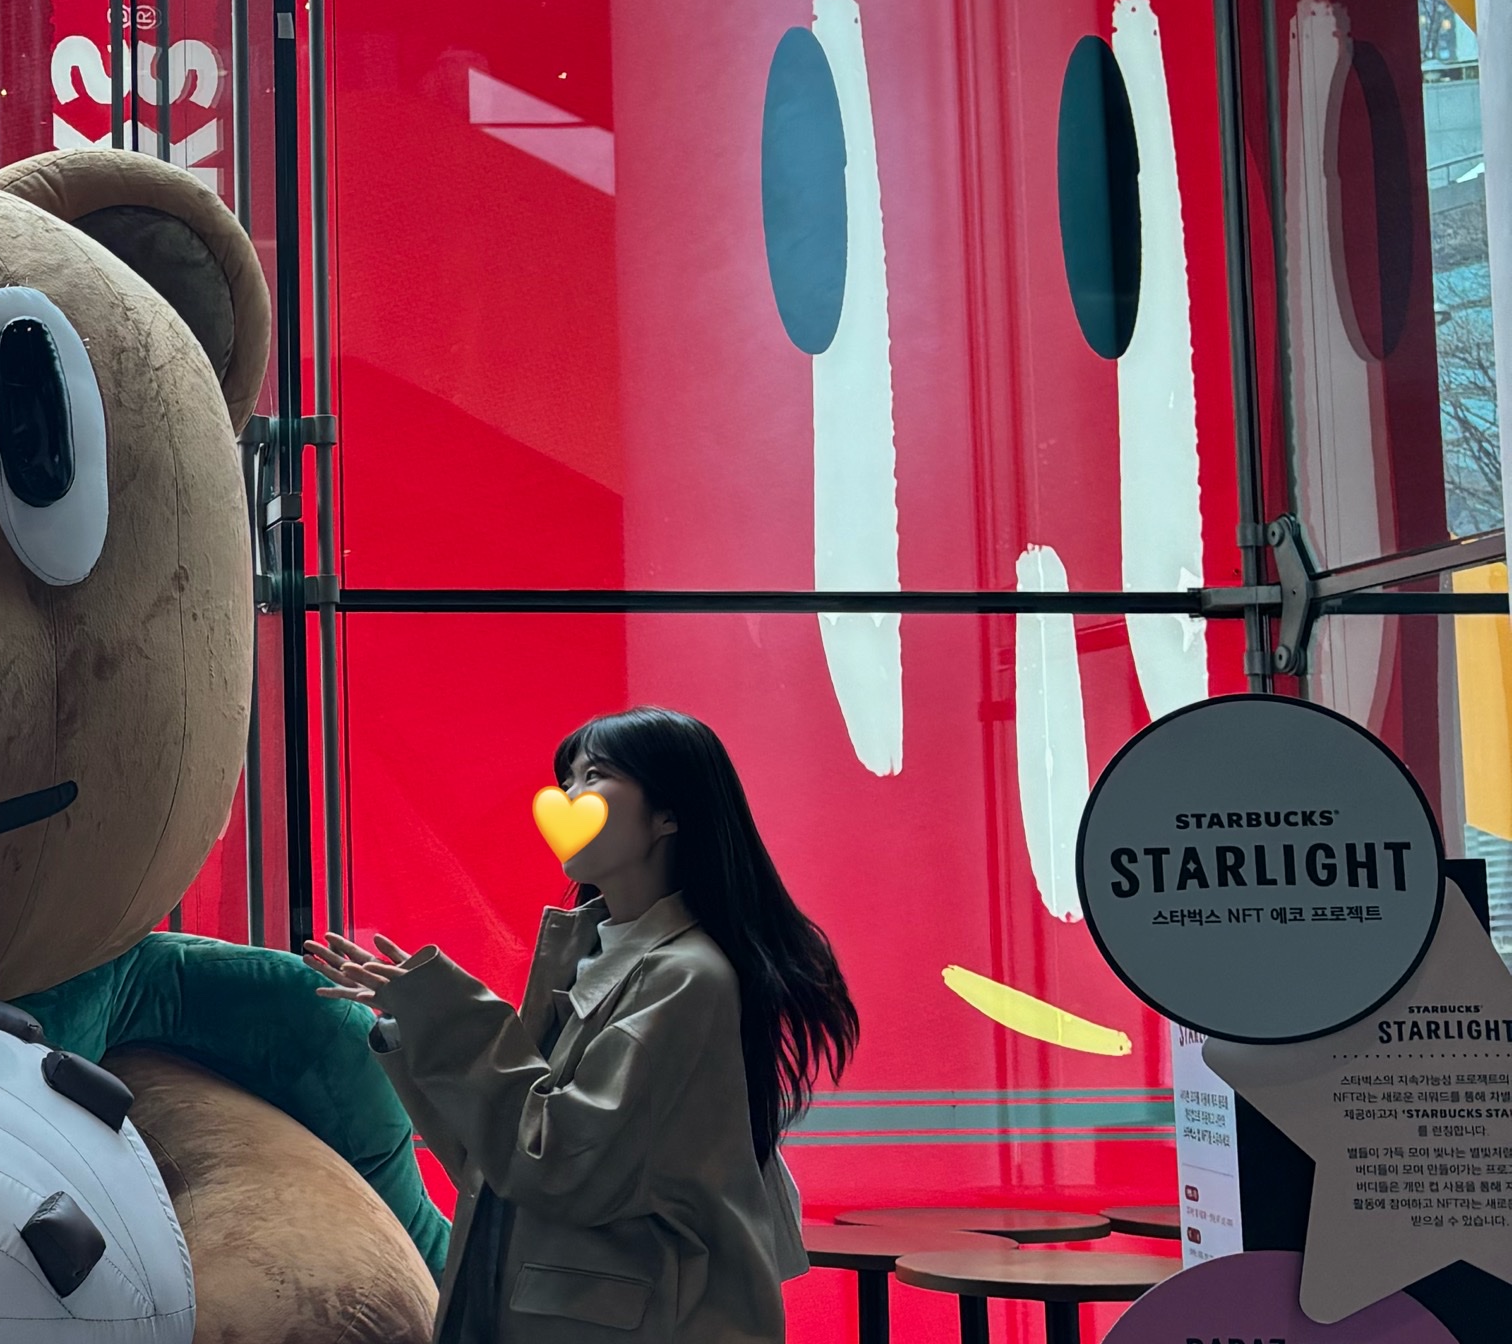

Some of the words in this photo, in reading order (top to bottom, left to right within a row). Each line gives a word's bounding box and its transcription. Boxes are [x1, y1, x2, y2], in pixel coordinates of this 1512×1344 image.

[1111, 842, 1411, 898] STARLIGHT
[1152, 909, 1221, 926] 스타벅스
[1228, 908, 1264, 923] NFT
[1271, 907, 1305, 924] 에코
[1311, 906, 1382, 923] 프로젝트
[1341, 1075, 1393, 1085] 스타벅스의
[1398, 1075, 1451, 1086] 지속가능성
[1456, 1074, 1509, 1085] 프로젝트의
[1334, 1092, 1377, 1103] NFT라는
[1381, 1092, 1413, 1103] 새로운
[1465, 1091, 1486, 1103] 통해
[1344, 1109, 1397, 1120] 제공하고자
[1347, 1148, 1379, 1159] 별들이
[1384, 1147, 1404, 1158] 가득
[1434, 1148, 1465, 1158] 빛나는
[1356, 1164, 1398, 1176] 버디들이
[1357, 1182, 1399, 1193] 버디들은
[1404, 1182, 1424, 1192] 개인
[1429, 1182, 1439, 1192] 컵
[1443, 1181, 1475, 1192] 사용을
[1480, 1181, 1501, 1192] 통해
[1390, 1199, 1433, 1209] 참여하고
[1437, 1198, 1481, 1209] NFT라는
[1411, 1216, 1443, 1227] 받으실
[1448, 1217, 1458, 1226] 수
[1462, 1215, 1509, 1226] 있습니다.
